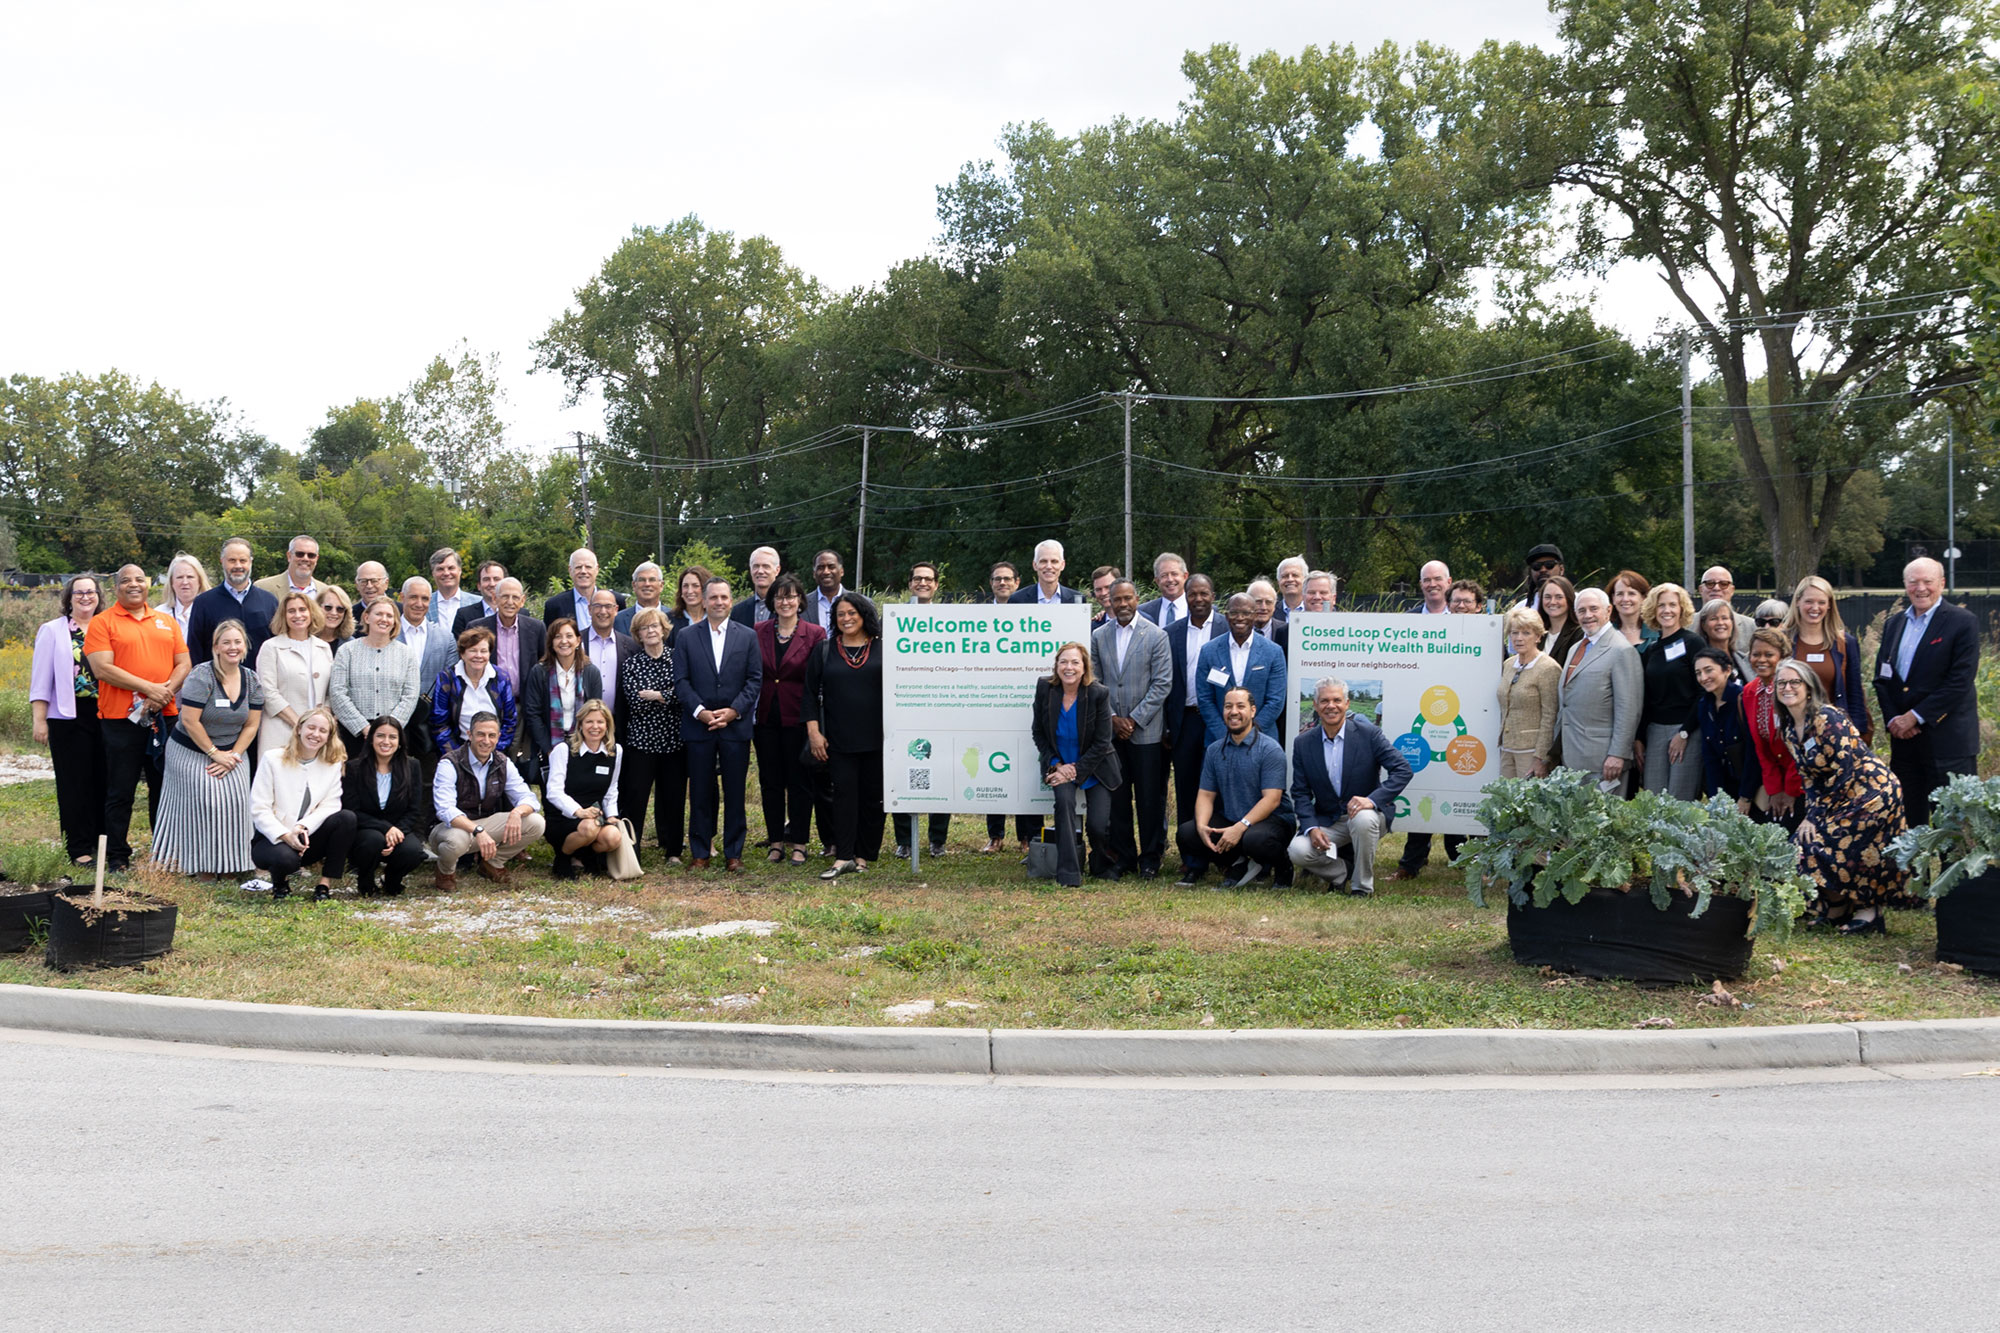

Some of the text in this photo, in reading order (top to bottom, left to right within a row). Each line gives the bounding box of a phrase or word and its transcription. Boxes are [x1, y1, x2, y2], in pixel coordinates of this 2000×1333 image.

[896, 616, 1052, 633] Welcome to the
[1302, 626, 1447, 640] Closed Loop Cycle and
[896, 637, 956, 654] Green
[962, 637, 990, 654] Era
[1301, 640, 1482, 657] Community Wealth Building
[1301, 660, 1337, 669] Investing
[1338, 660, 1345, 668] in
[1361, 661, 1420, 670] neighborhood.
